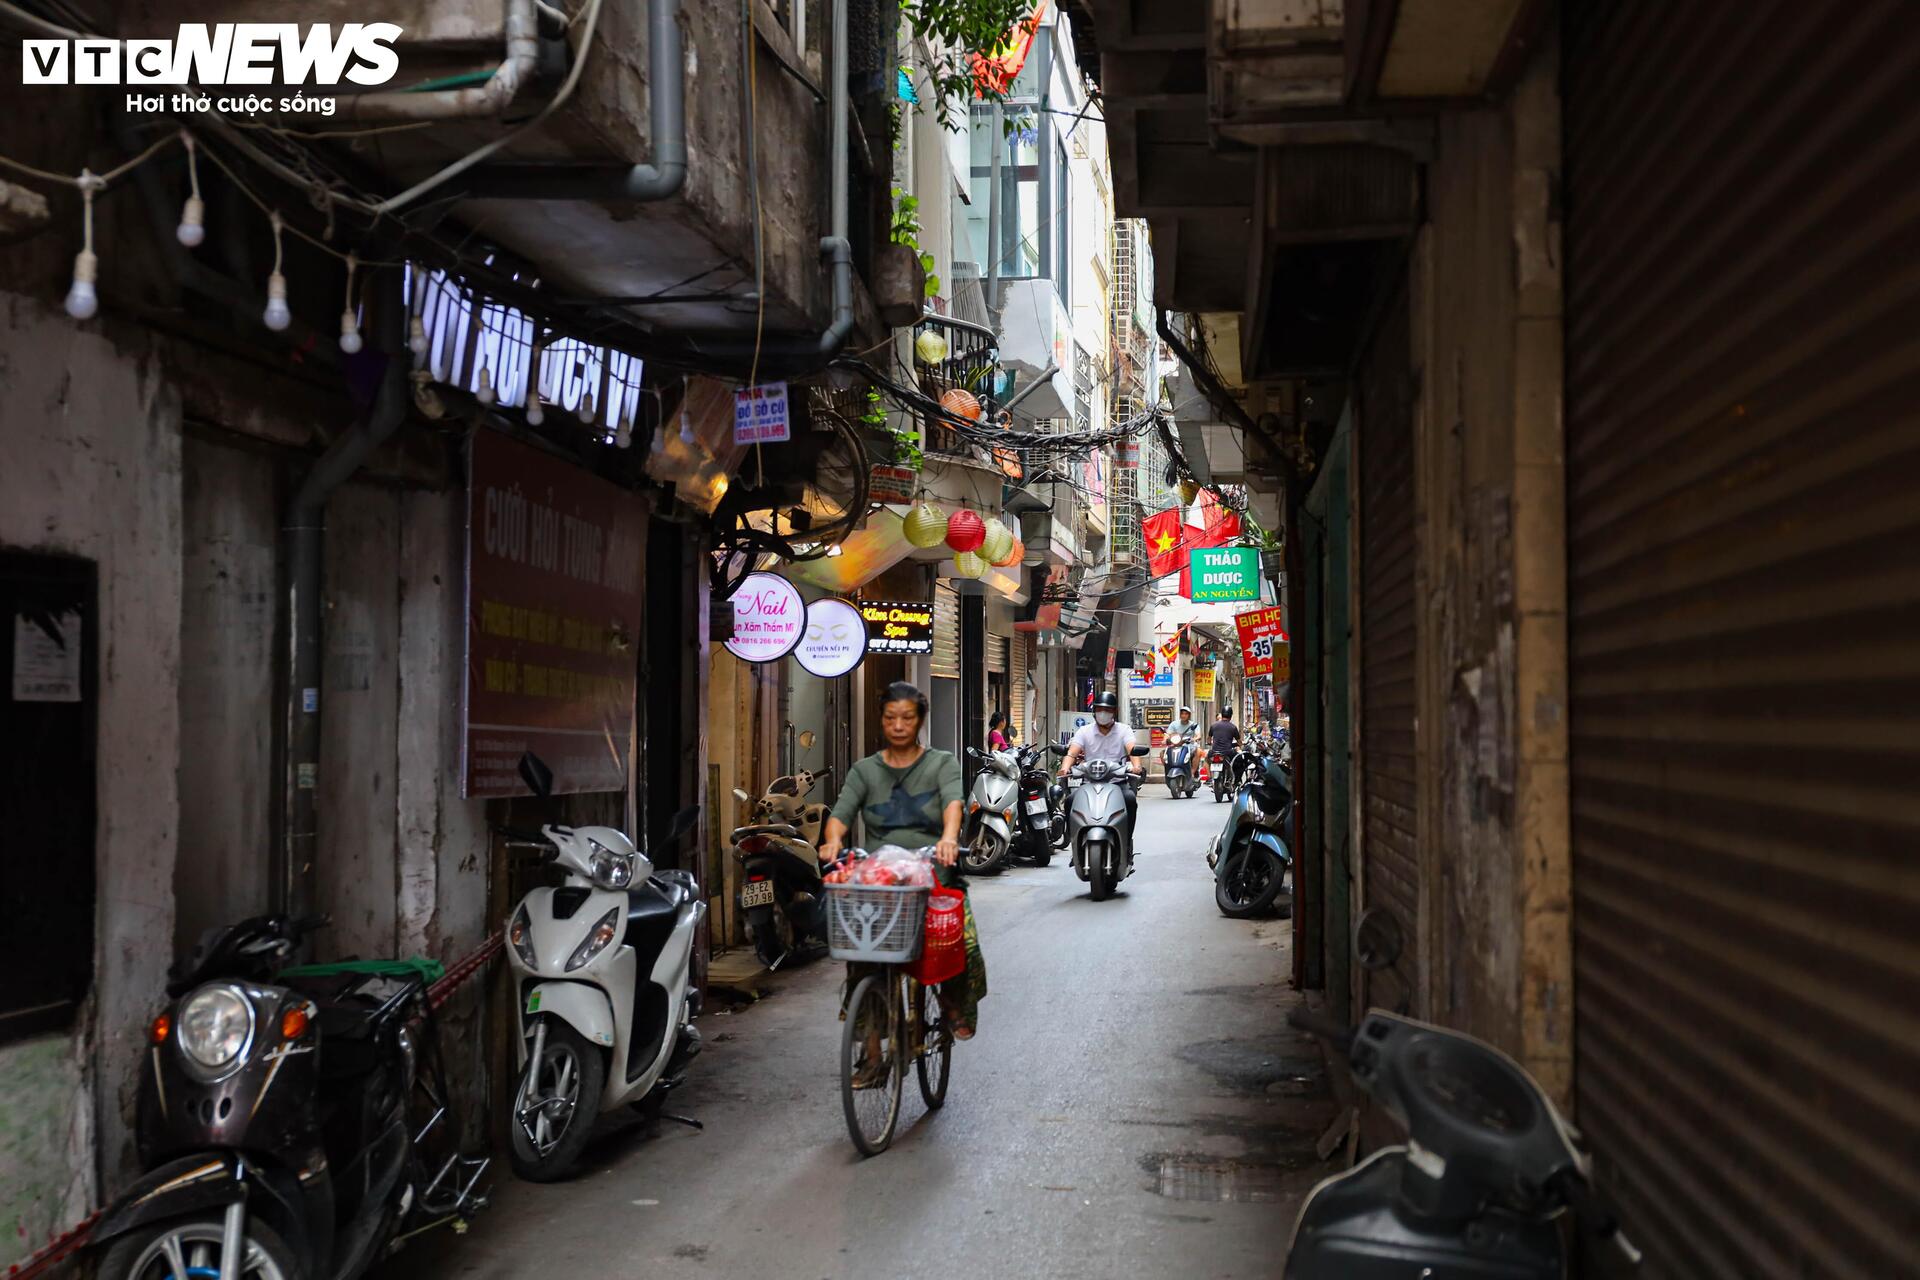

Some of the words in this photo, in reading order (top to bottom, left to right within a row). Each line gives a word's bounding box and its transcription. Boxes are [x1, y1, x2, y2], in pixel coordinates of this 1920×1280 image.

[484, 481, 529, 564] CƯỚI
[531, 486, 560, 572] HỎI
[1203, 550, 1242, 566] THẢO
[1203, 572, 1243, 587] DƯỢC
[737, 590, 789, 616] Nail
[862, 608, 888, 622] Kim
[889, 608, 930, 625] Chung
[1239, 613, 1261, 628] BIA
[743, 621, 761, 632] Xăm
[884, 623, 908, 638] Spa
[745, 881, 769, 895] 29-E2
[743, 892, 773, 907] 637.98
